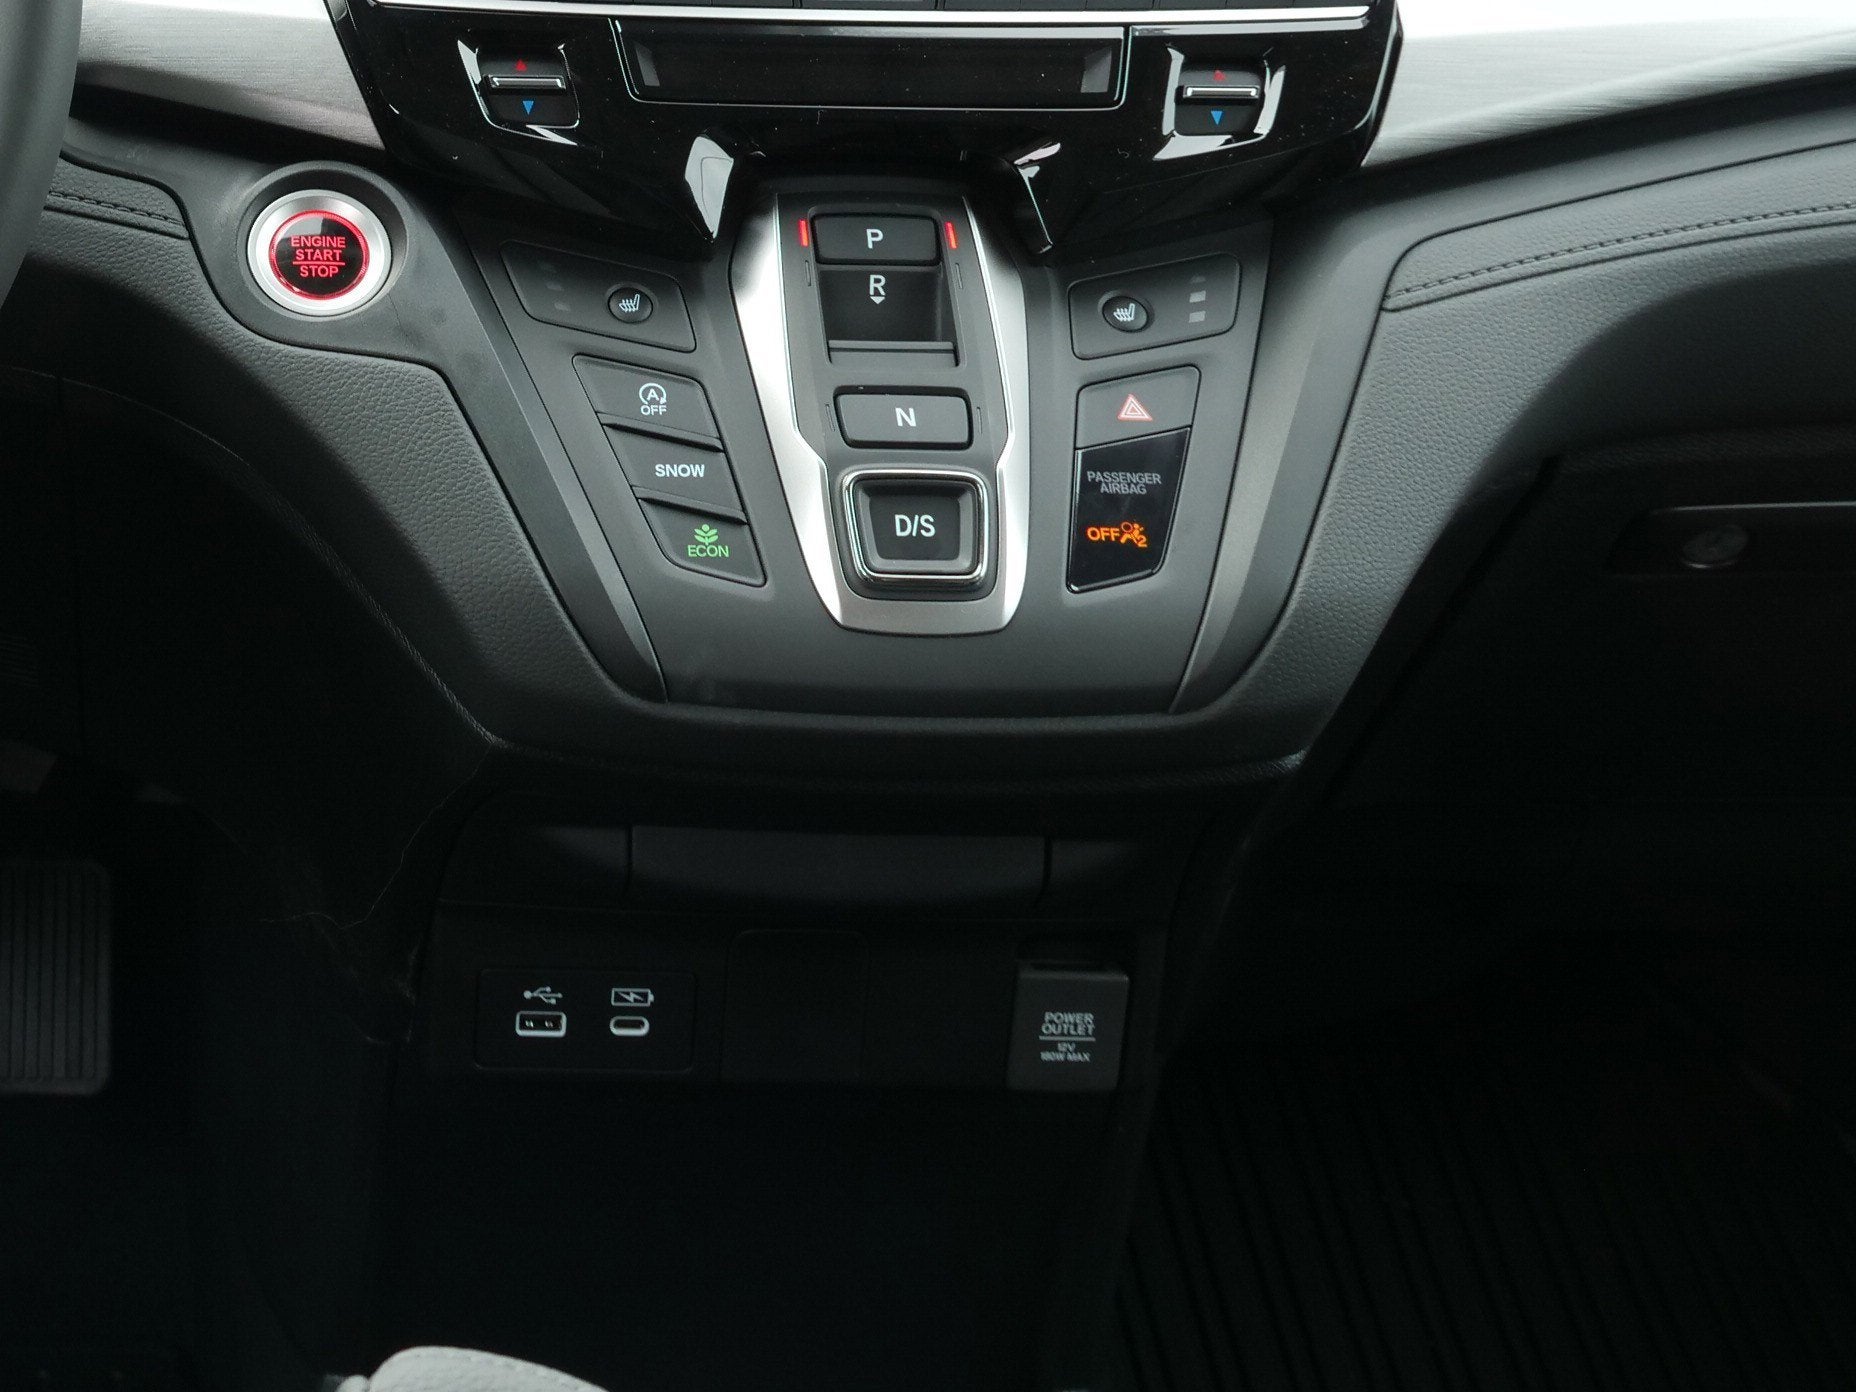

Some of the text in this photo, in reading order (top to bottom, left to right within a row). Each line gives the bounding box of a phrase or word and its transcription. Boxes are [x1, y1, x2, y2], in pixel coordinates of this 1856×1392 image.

[290, 235, 346, 249] ENGINE
[866, 227, 884, 249] P
[295, 249, 343, 262] START
[299, 265, 340, 278] STOP
[868, 274, 886, 296] R
[640, 404, 668, 416] OFF
[895, 407, 917, 427] N
[655, 464, 706, 478] SNOW
[1086, 470, 1162, 485] PASSENGER
[1099, 482, 1148, 495] AIRBAG
[894, 514, 937, 538] D/S
[1086, 526, 1120, 542] OFF
[687, 544, 730, 558] ECON
[1044, 1011, 1094, 1024] POWER
[1041, 1022, 1095, 1036] OUTLET
